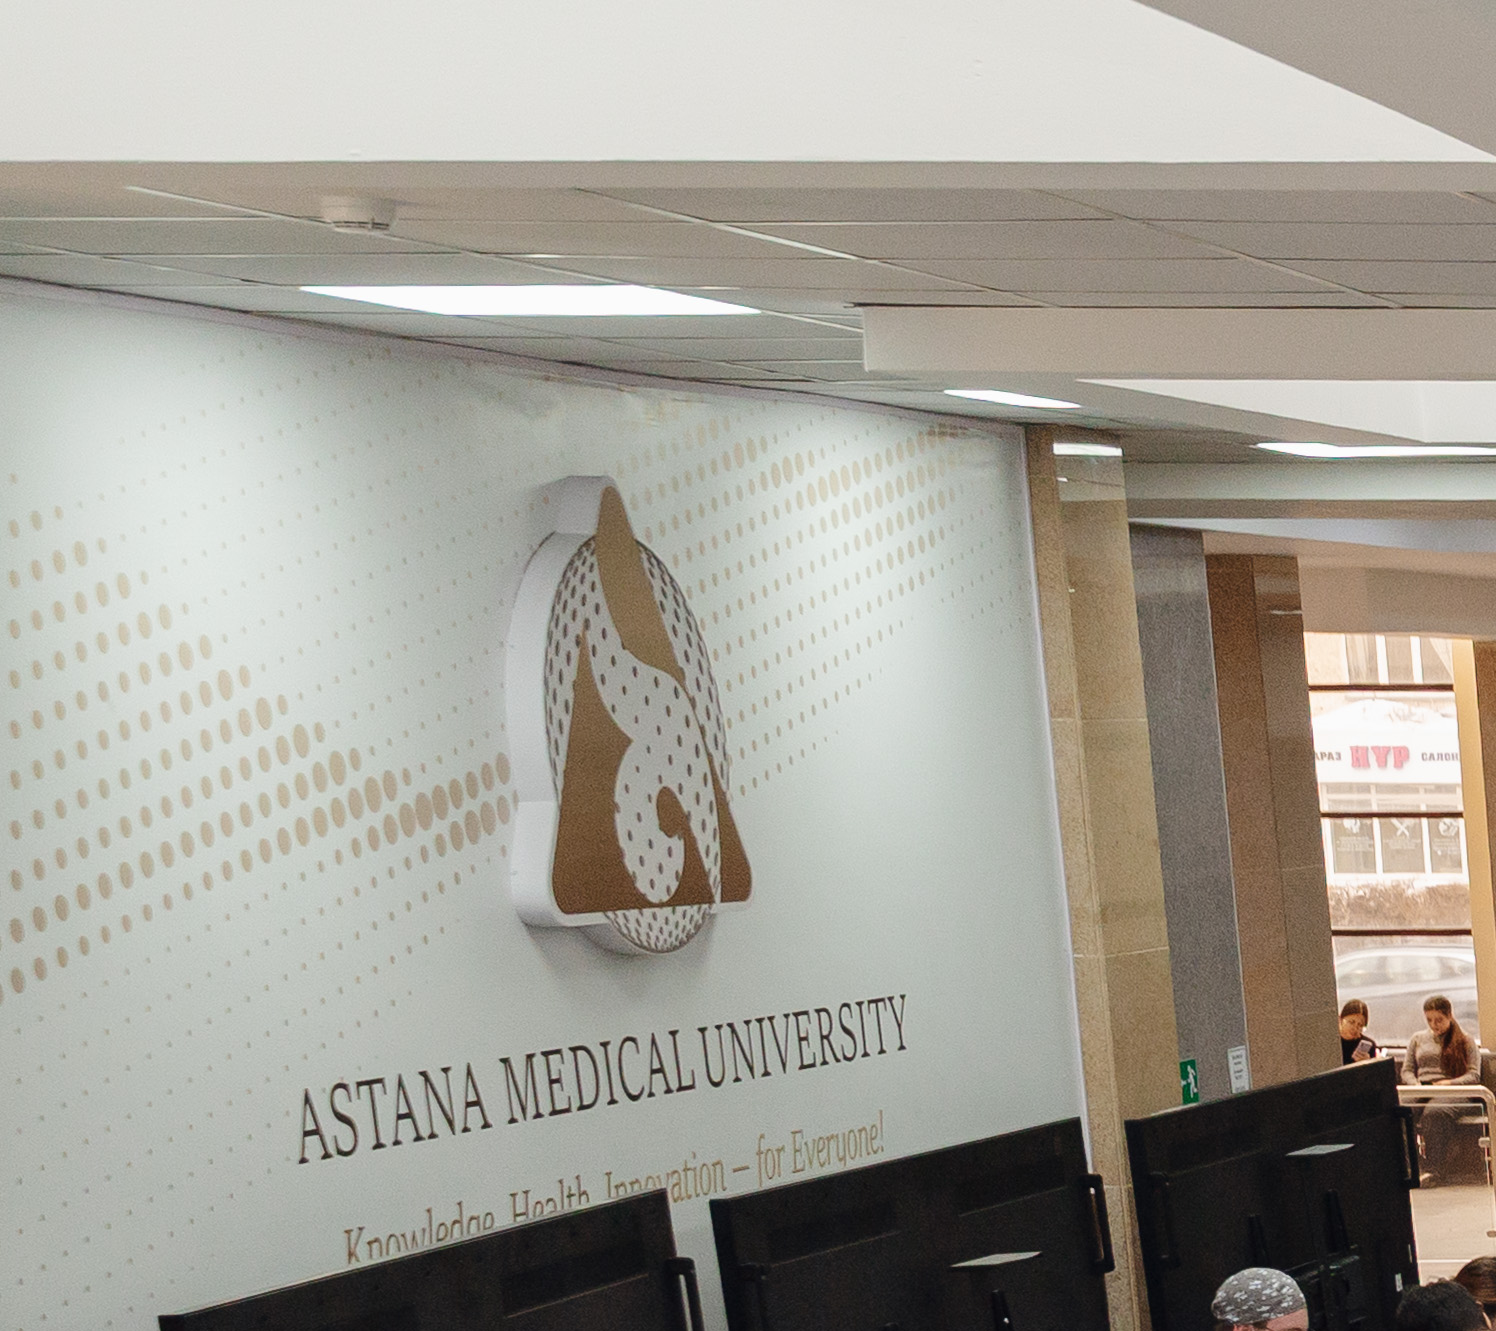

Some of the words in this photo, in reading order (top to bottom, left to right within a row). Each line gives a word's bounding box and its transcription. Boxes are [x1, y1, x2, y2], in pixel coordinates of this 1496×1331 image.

[298, 1062, 493, 1164] ASTANA
[498, 1029, 696, 1125] MEDICAL
[697, 994, 908, 1088] UNIVERSITY
[755, 1133, 786, 1187] for
[790, 1108, 885, 1175] Everyone!
